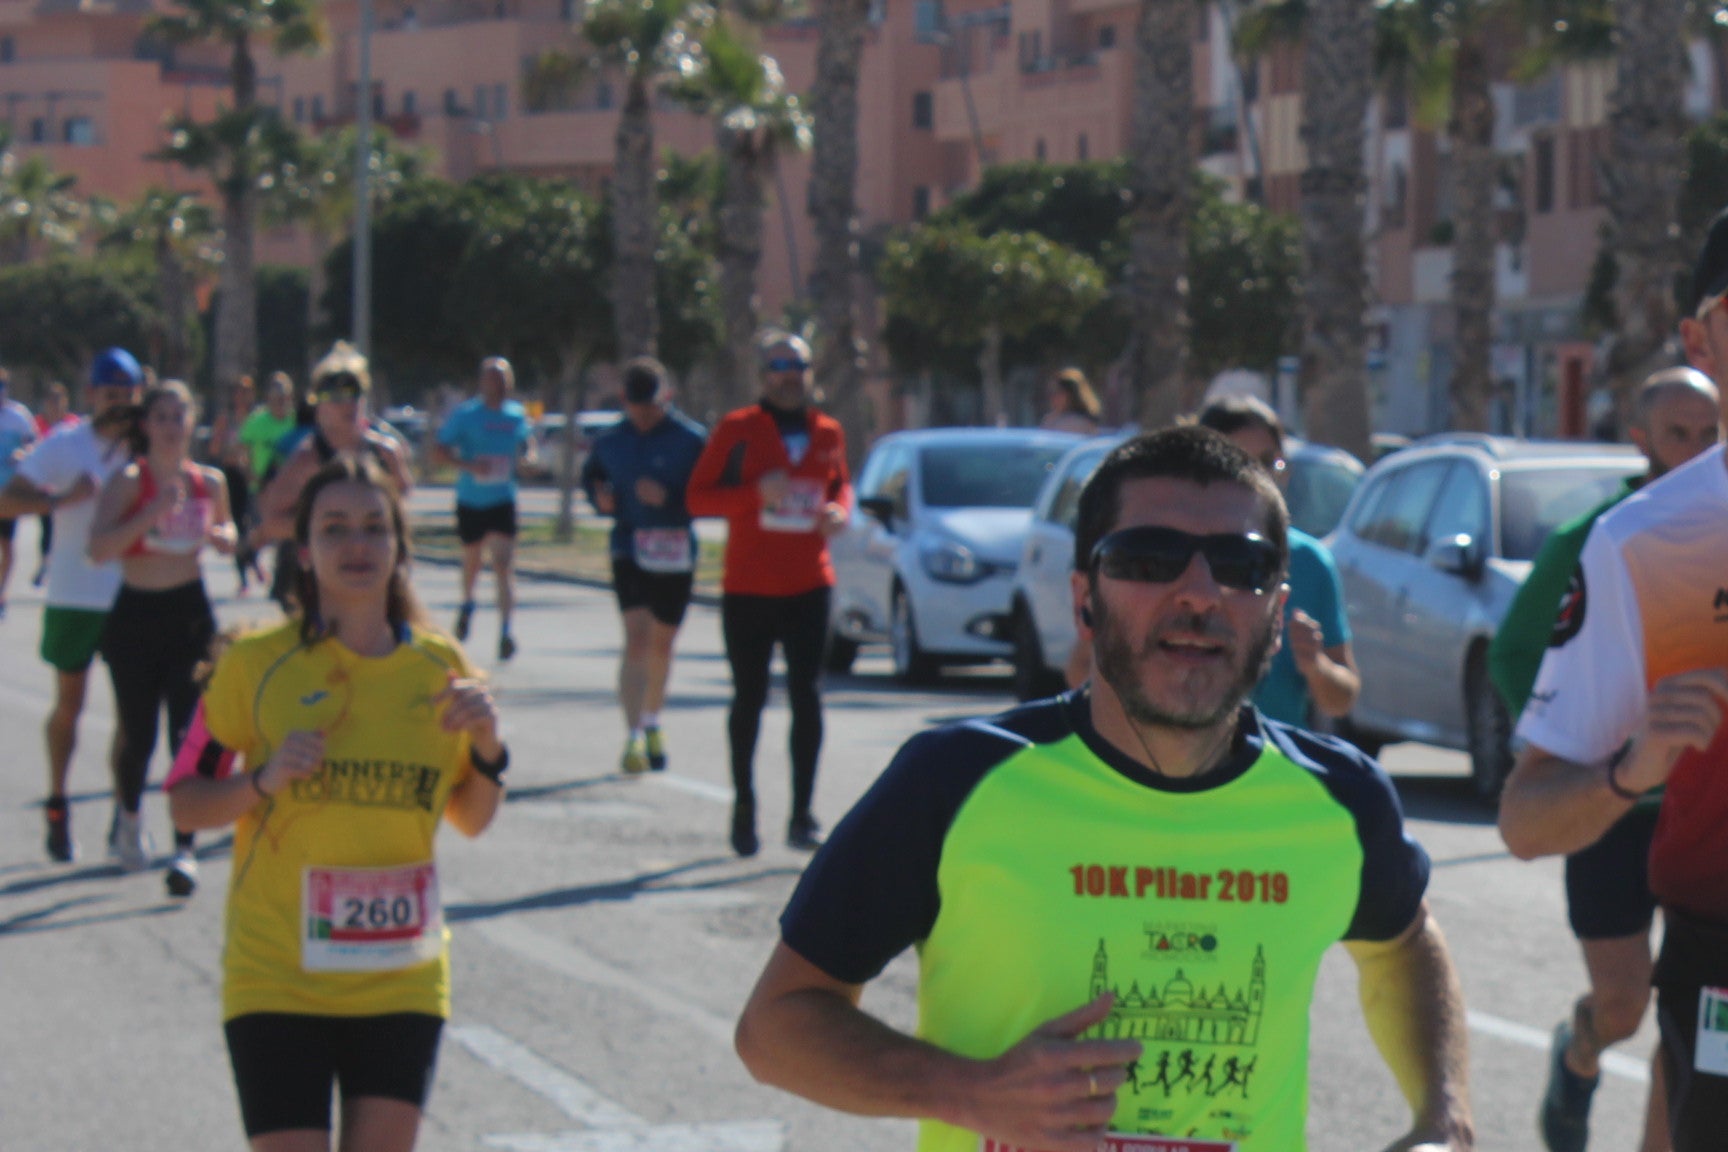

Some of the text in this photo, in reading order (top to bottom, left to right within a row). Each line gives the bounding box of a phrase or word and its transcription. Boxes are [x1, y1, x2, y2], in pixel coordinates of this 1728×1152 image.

[1069, 864, 1129, 897] 10K
[1217, 869, 1289, 904] 2019
[345, 896, 411, 930] 260
